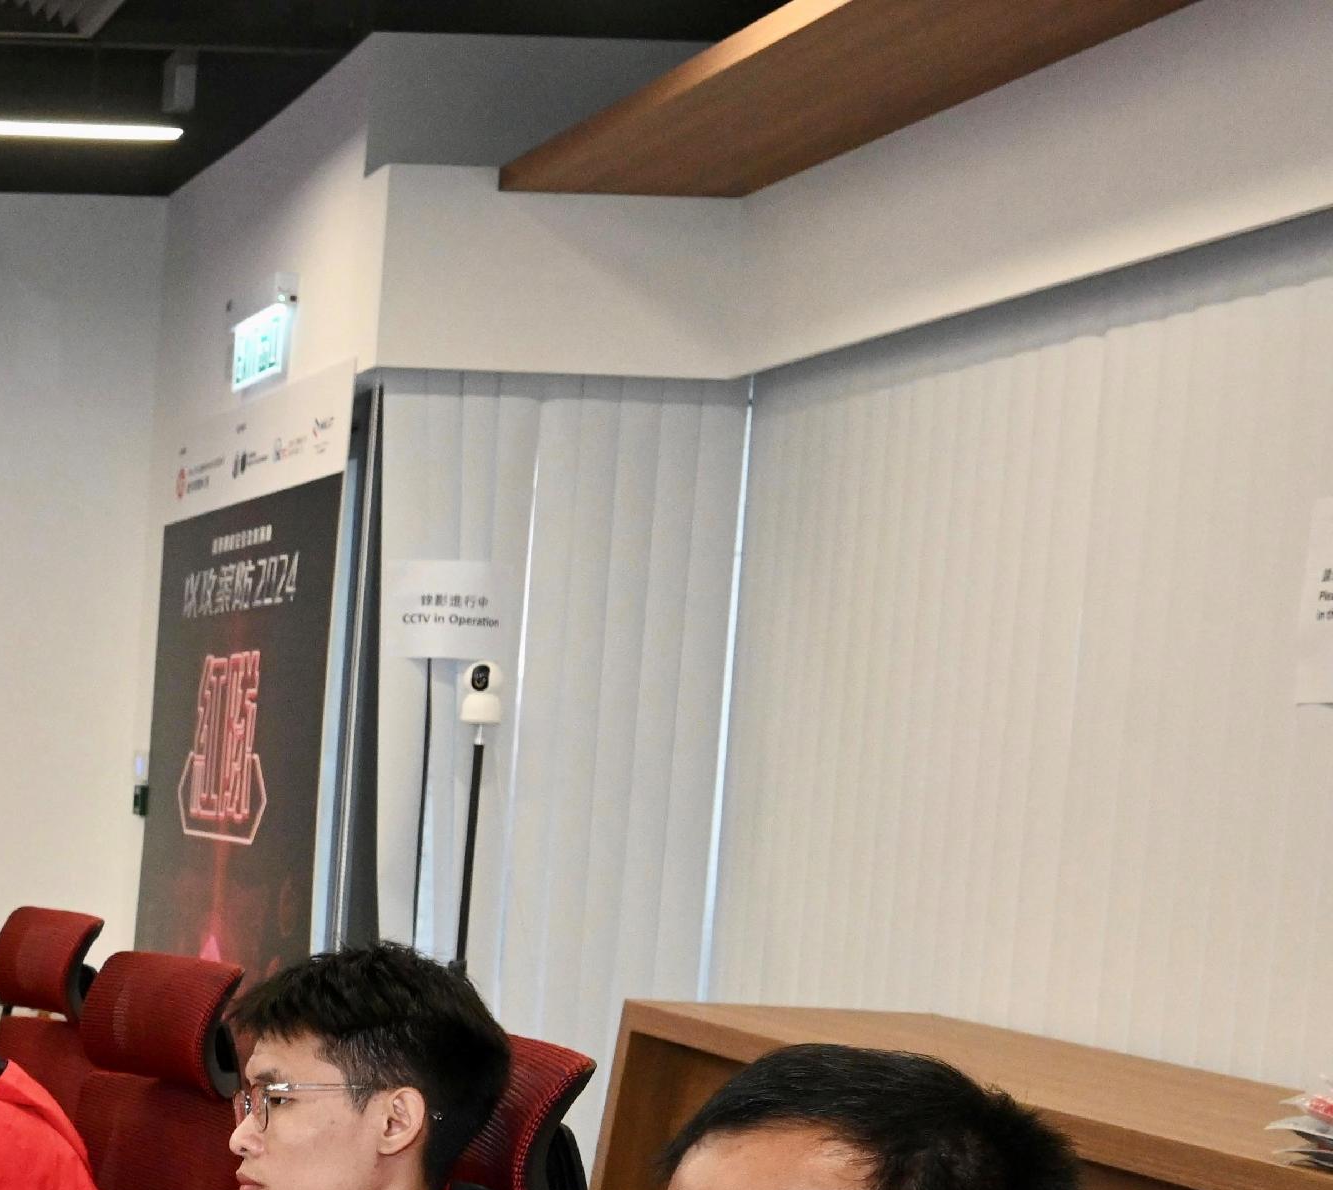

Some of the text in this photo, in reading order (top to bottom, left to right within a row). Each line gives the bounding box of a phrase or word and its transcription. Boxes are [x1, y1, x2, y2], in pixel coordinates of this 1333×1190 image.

[402, 613, 499, 627] CCTV in Operation
